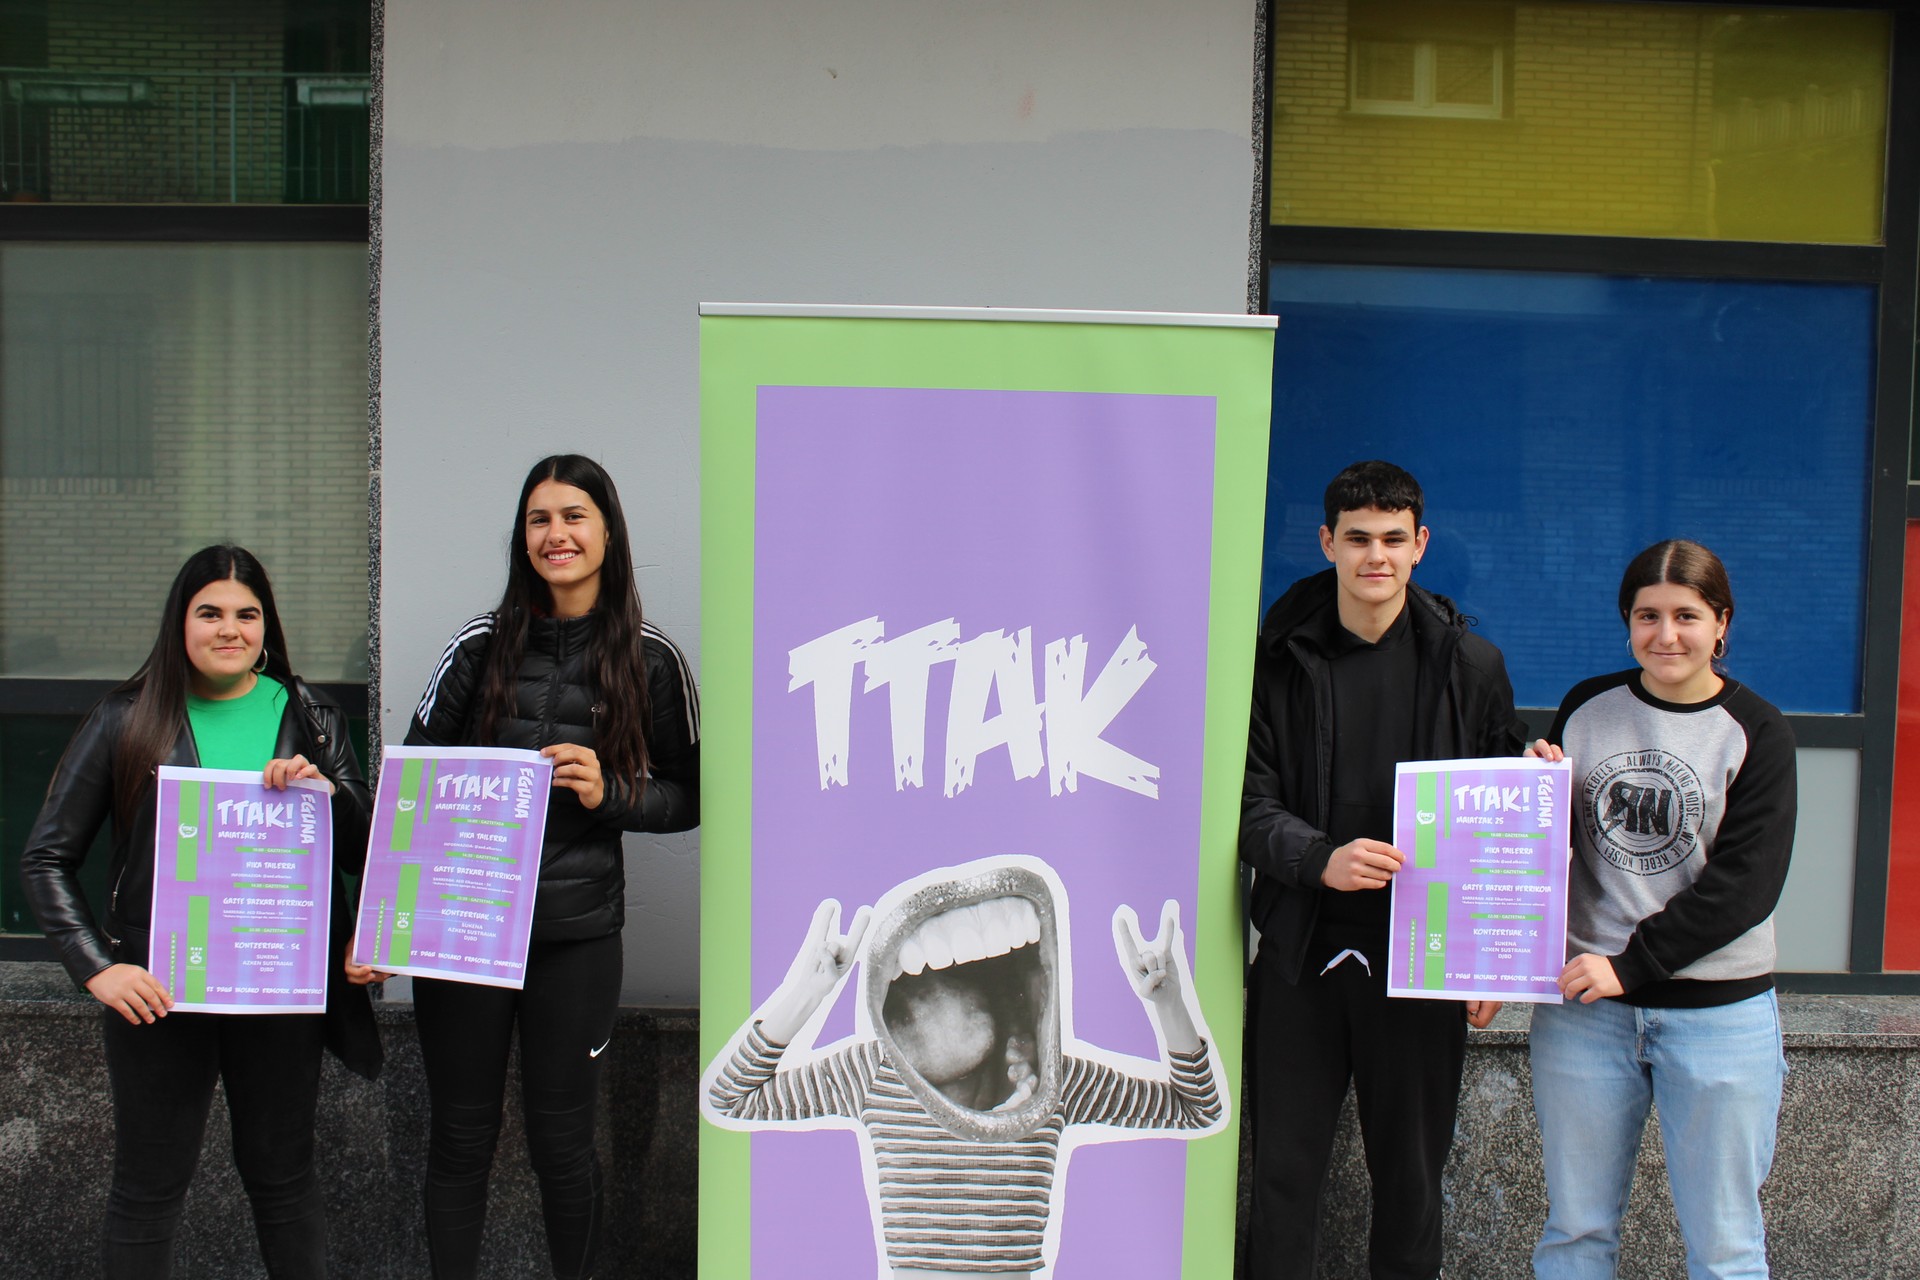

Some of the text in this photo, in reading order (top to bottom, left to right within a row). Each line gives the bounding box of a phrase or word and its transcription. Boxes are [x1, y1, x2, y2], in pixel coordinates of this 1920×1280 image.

[788, 615, 1160, 800] TTAK
[1663, 759, 1694, 787] MAKING
[437, 774, 511, 801] TTAK!
[514, 767, 534, 818] EGUNA
[1454, 784, 1530, 812] TTAK!
[217, 799, 294, 828] TTAK!
[435, 803, 470, 811] MAIATZAK
[1537, 775, 1554, 828] EGUNA
[300, 794, 316, 844] EGUNA
[1456, 816, 1493, 824] MAIATZAK
[218, 831, 256, 840] MAIATZAK
[477, 833, 507, 842] TAILERRA
[1604, 845, 1633, 867] NOISE!
[1640, 854, 1670, 871] REBEL
[441, 908, 490, 920] KONTZERTUAK
